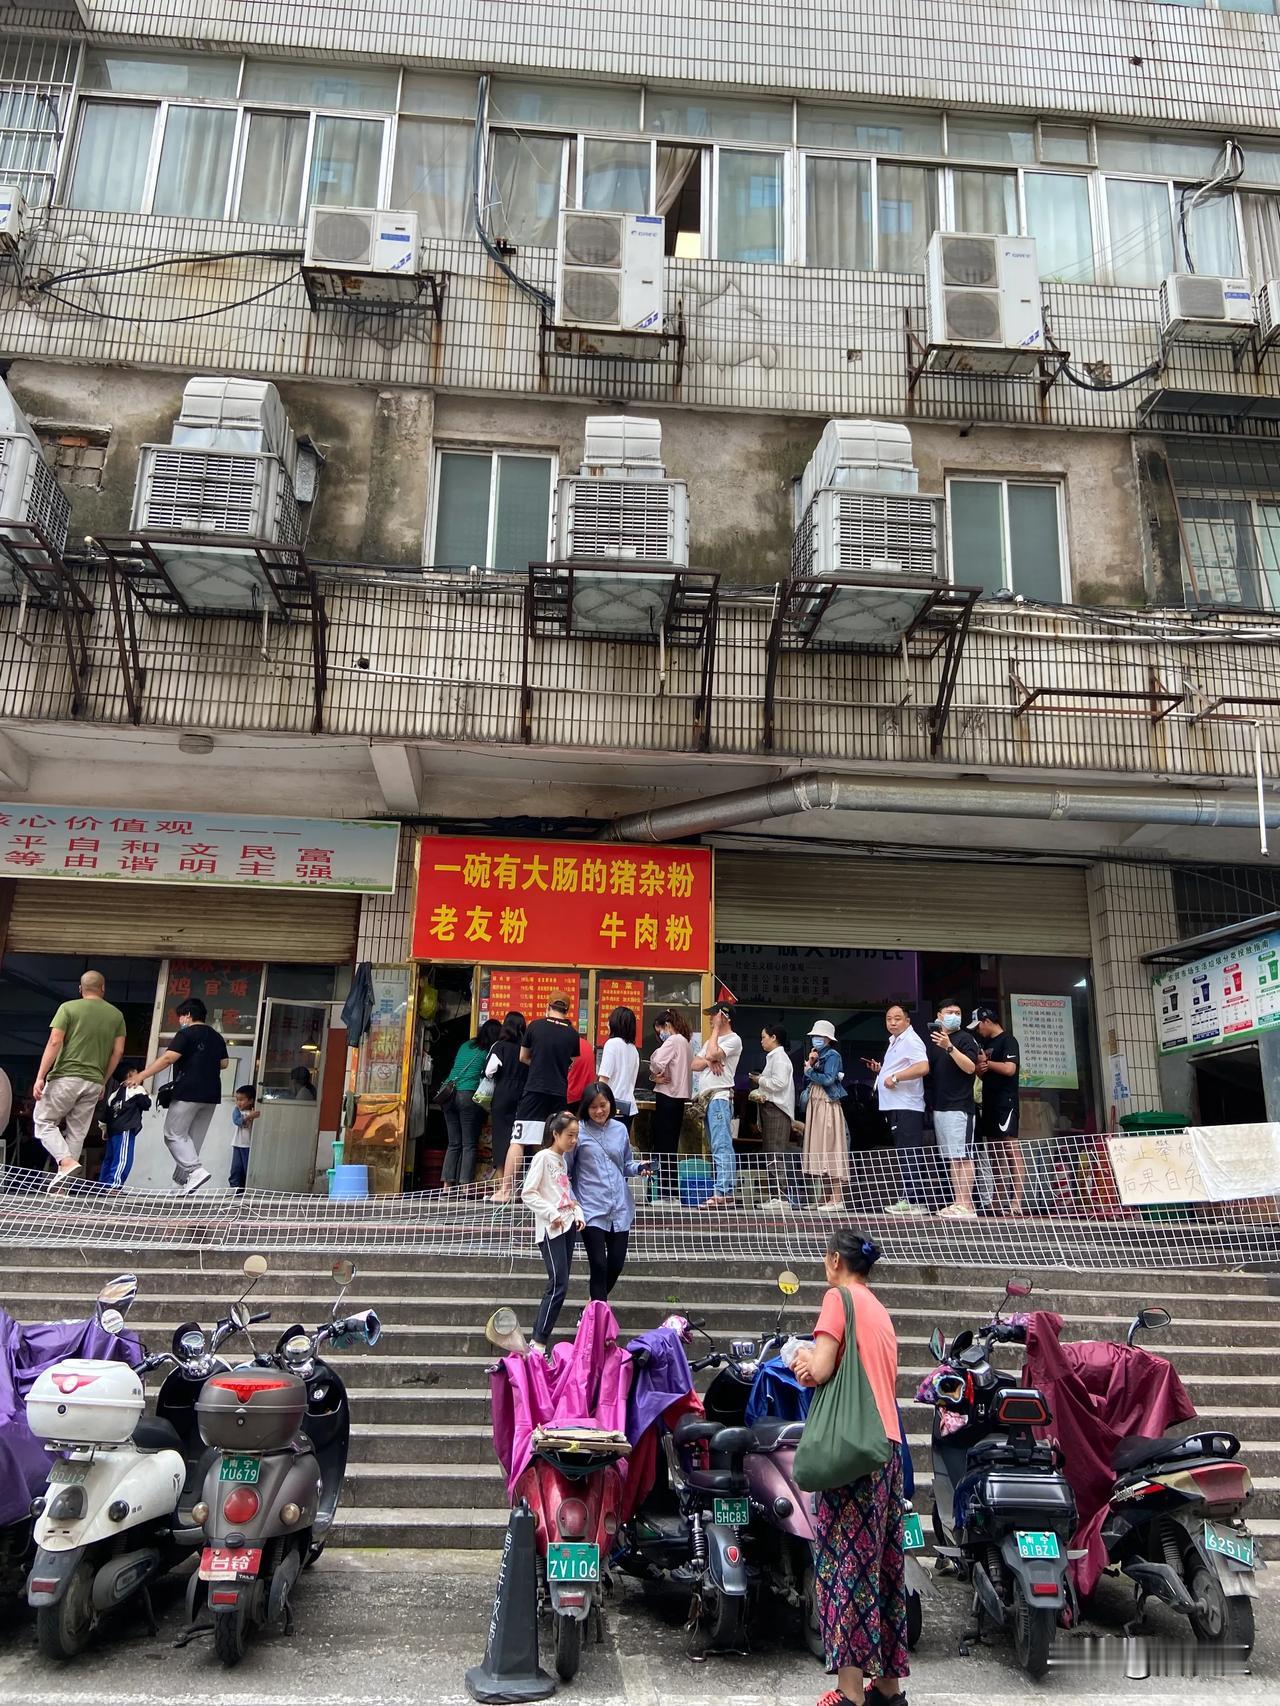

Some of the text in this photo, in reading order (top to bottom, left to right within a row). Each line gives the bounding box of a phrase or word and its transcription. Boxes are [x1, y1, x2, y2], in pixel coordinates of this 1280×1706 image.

[434, 852, 694, 898] 一碗有大肠的猪杂粉
[429, 904, 528, 944] 老友粉
[599, 911, 693, 952] 牛肉粉
[1123, 1163, 1204, 1196] 后果自负
[229, 1459, 253, 1468] 南宁
[222, 1467, 257, 1481] YU679
[716, 1511, 747, 1523] 5HC83
[1022, 1544, 1055, 1556] 81BZ1
[1208, 1534, 1251, 1562] 62517
[211, 1555, 250, 1571] 台铃
[549, 1559, 597, 1578] ZV106
